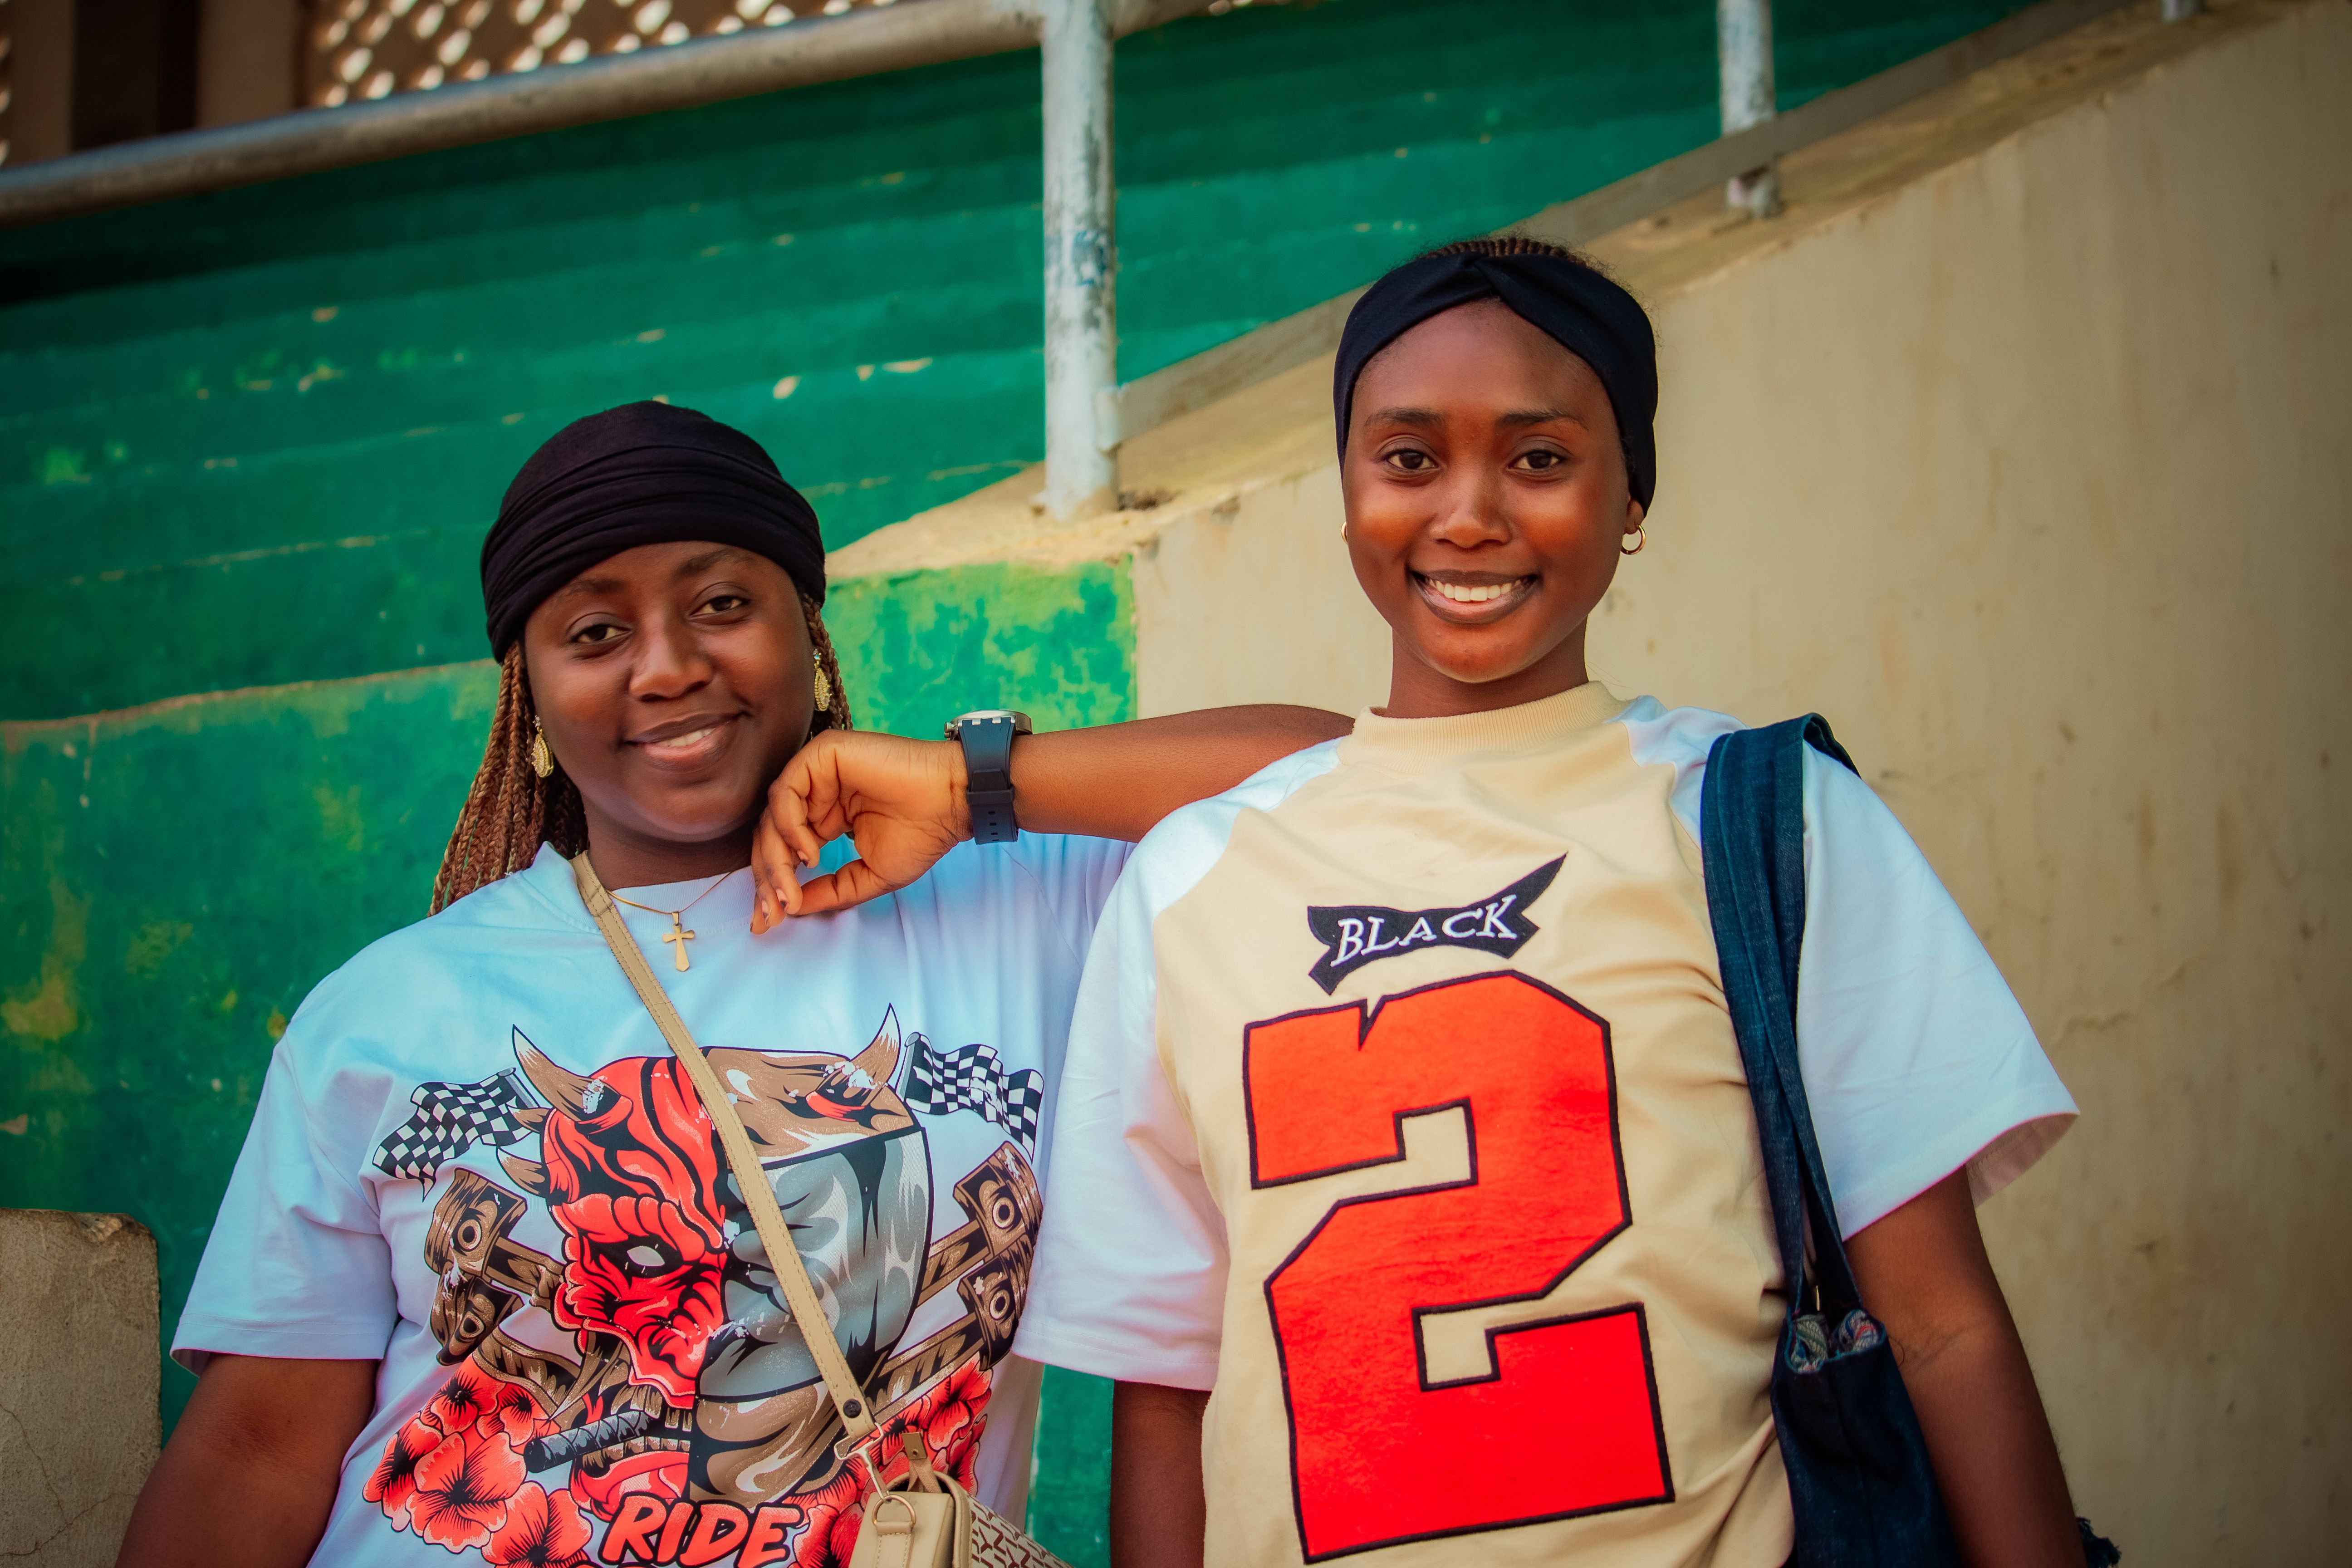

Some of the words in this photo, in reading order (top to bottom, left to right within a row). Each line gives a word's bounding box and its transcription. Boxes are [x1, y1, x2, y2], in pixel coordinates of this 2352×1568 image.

[1330, 894, 1518, 967] BLACK
[1243, 969, 1676, 1565] 2
[598, 1493, 804, 1568] RIDE
